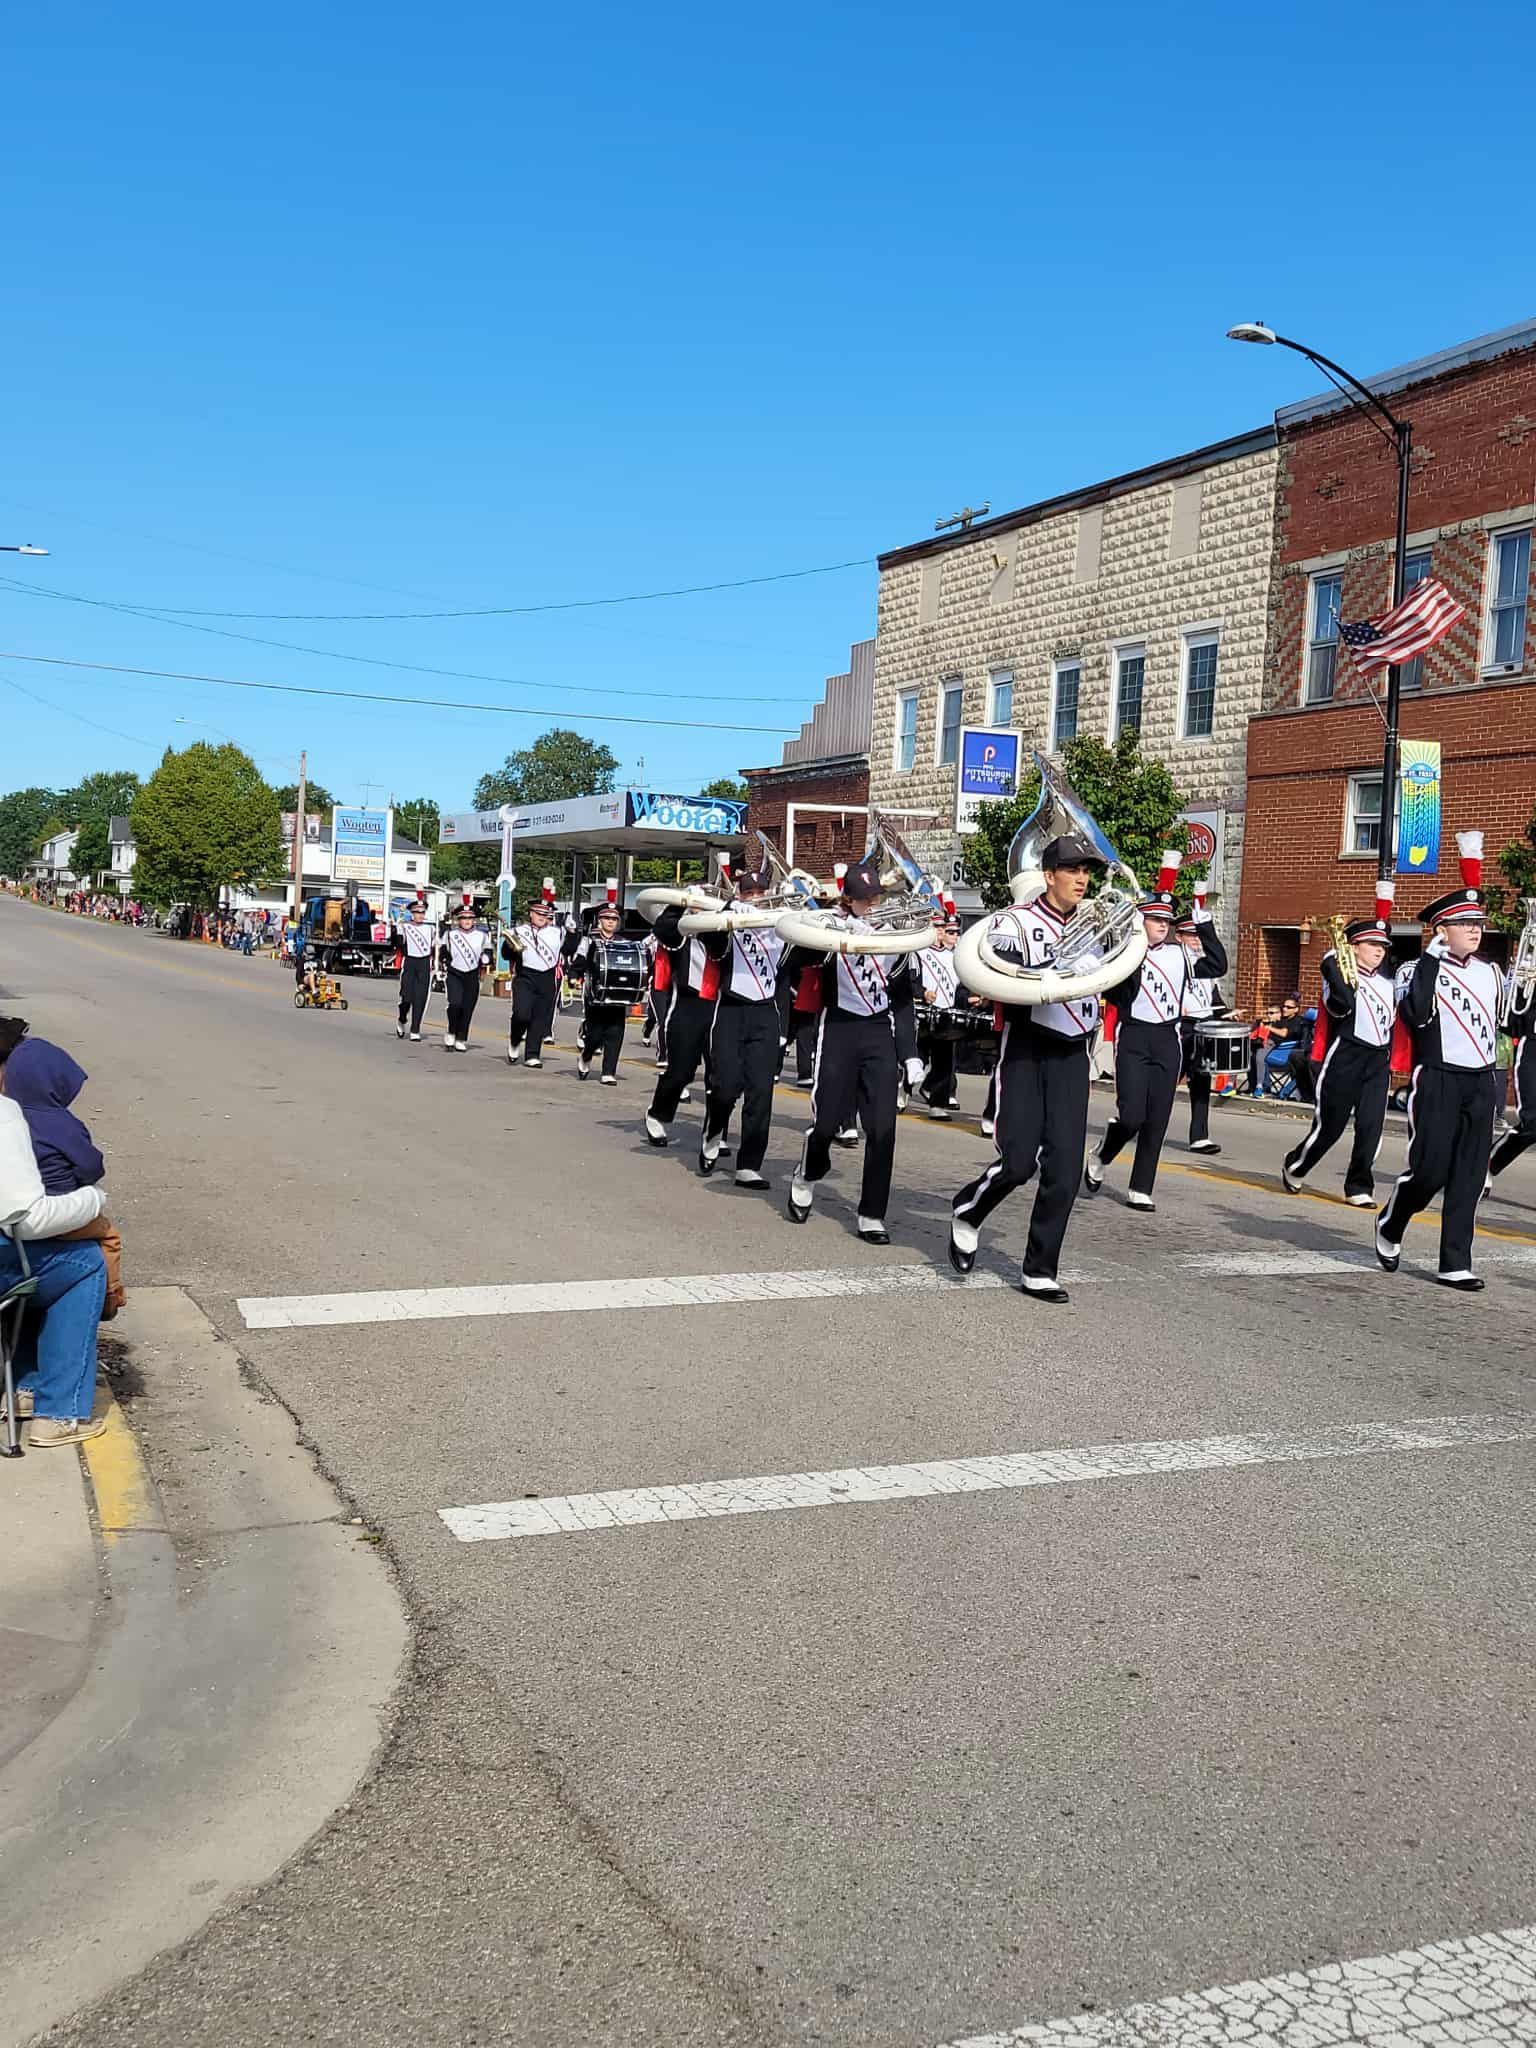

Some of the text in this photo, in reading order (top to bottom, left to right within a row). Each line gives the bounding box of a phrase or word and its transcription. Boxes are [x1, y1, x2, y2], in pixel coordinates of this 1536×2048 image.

[631, 791, 737, 835] Wooten
[737, 929, 773, 989] RAHAM
[1140, 963, 1175, 1017] RAHAM
[1439, 974, 1494, 1056] GRAHAM
